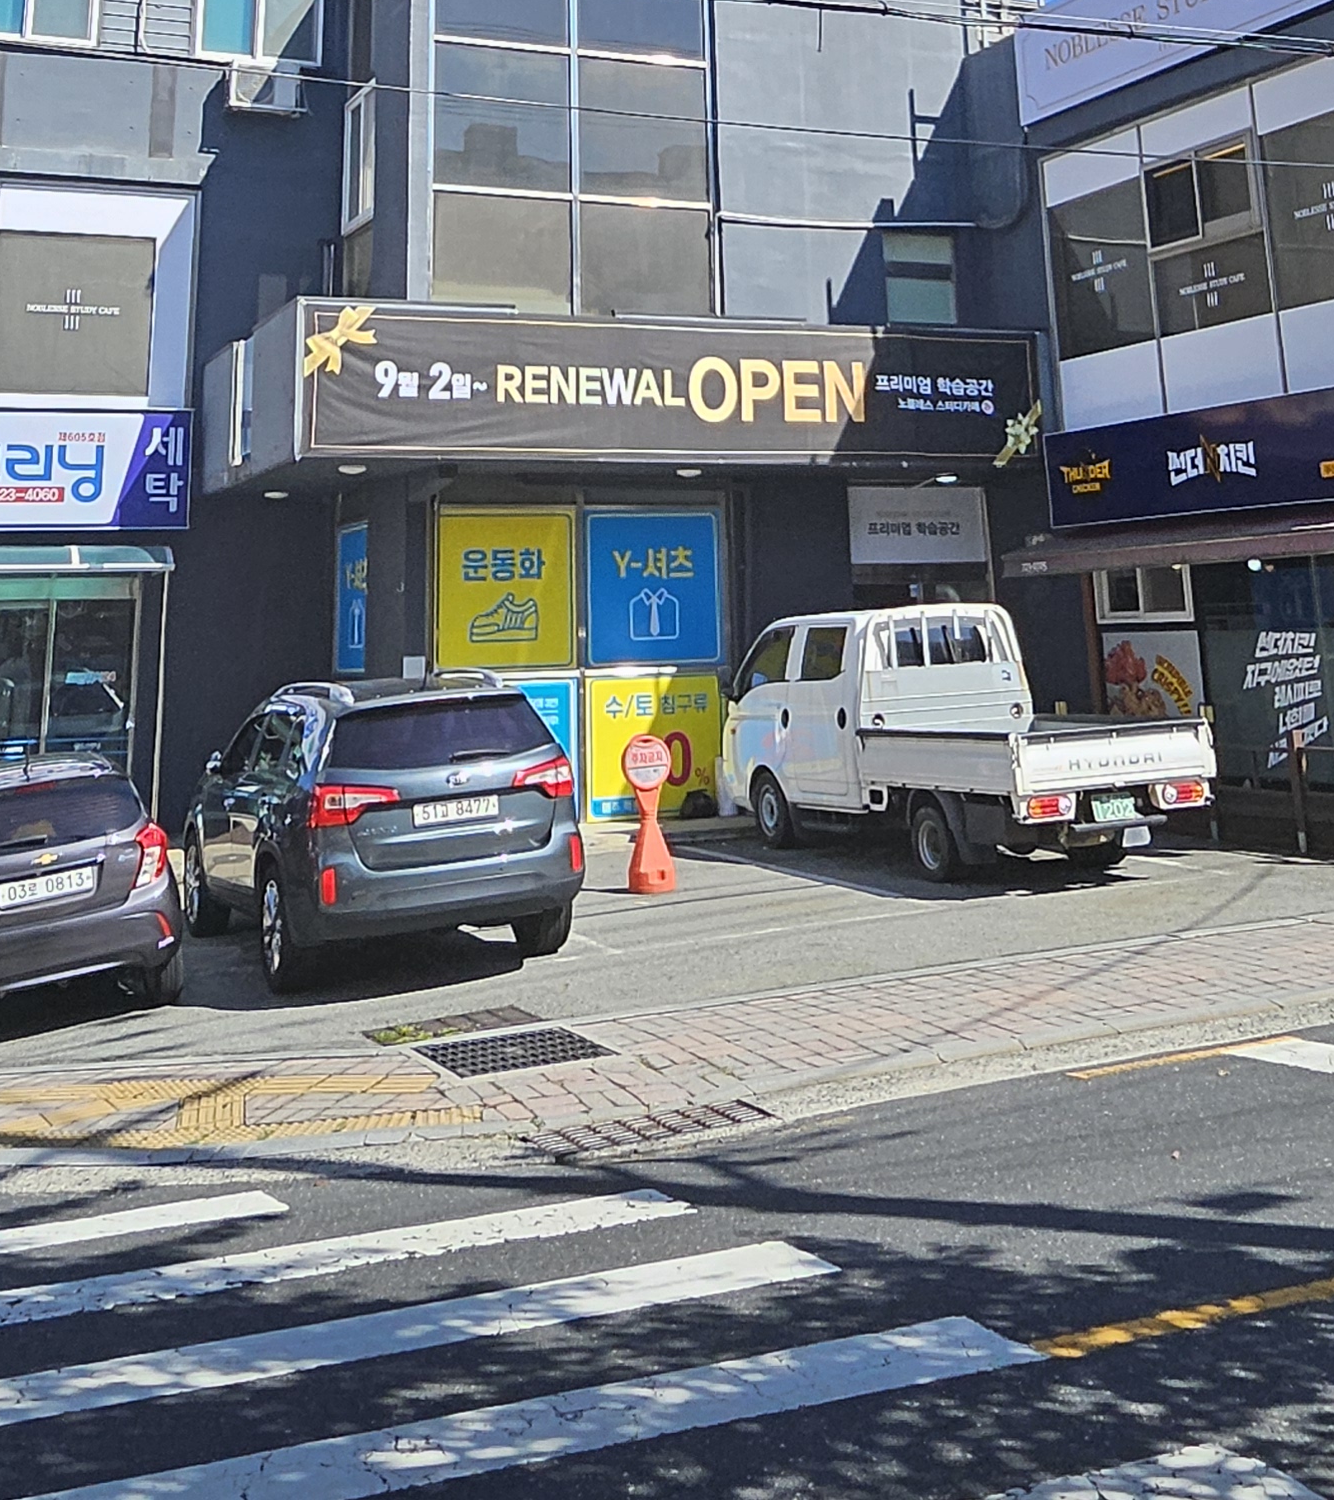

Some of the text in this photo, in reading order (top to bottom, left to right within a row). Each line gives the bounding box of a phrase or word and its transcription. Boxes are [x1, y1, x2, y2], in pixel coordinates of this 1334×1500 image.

[374, 360, 420, 398] 9월
[496, 364, 686, 407] RENEWAL
[688, 355, 866, 424] OPEN
[874, 373, 995, 398] 프리미엄 학습공간
[145, 426, 185, 514] 세탁
[1060, 458, 1112, 484] THUNDER
[867, 522, 961, 536] 프리미엄 학습공간
[461, 548, 545, 582] 운동화
[613, 547, 694, 579] Y-셔츠
[605, 693, 709, 719] 수/토 침구류
[630, 751, 664, 764] 주차금지
[1068, 751, 1163, 771] HYUNDAI
[455, 798, 491, 817] 8477
[7, 872, 86, 901] 03로 0813
